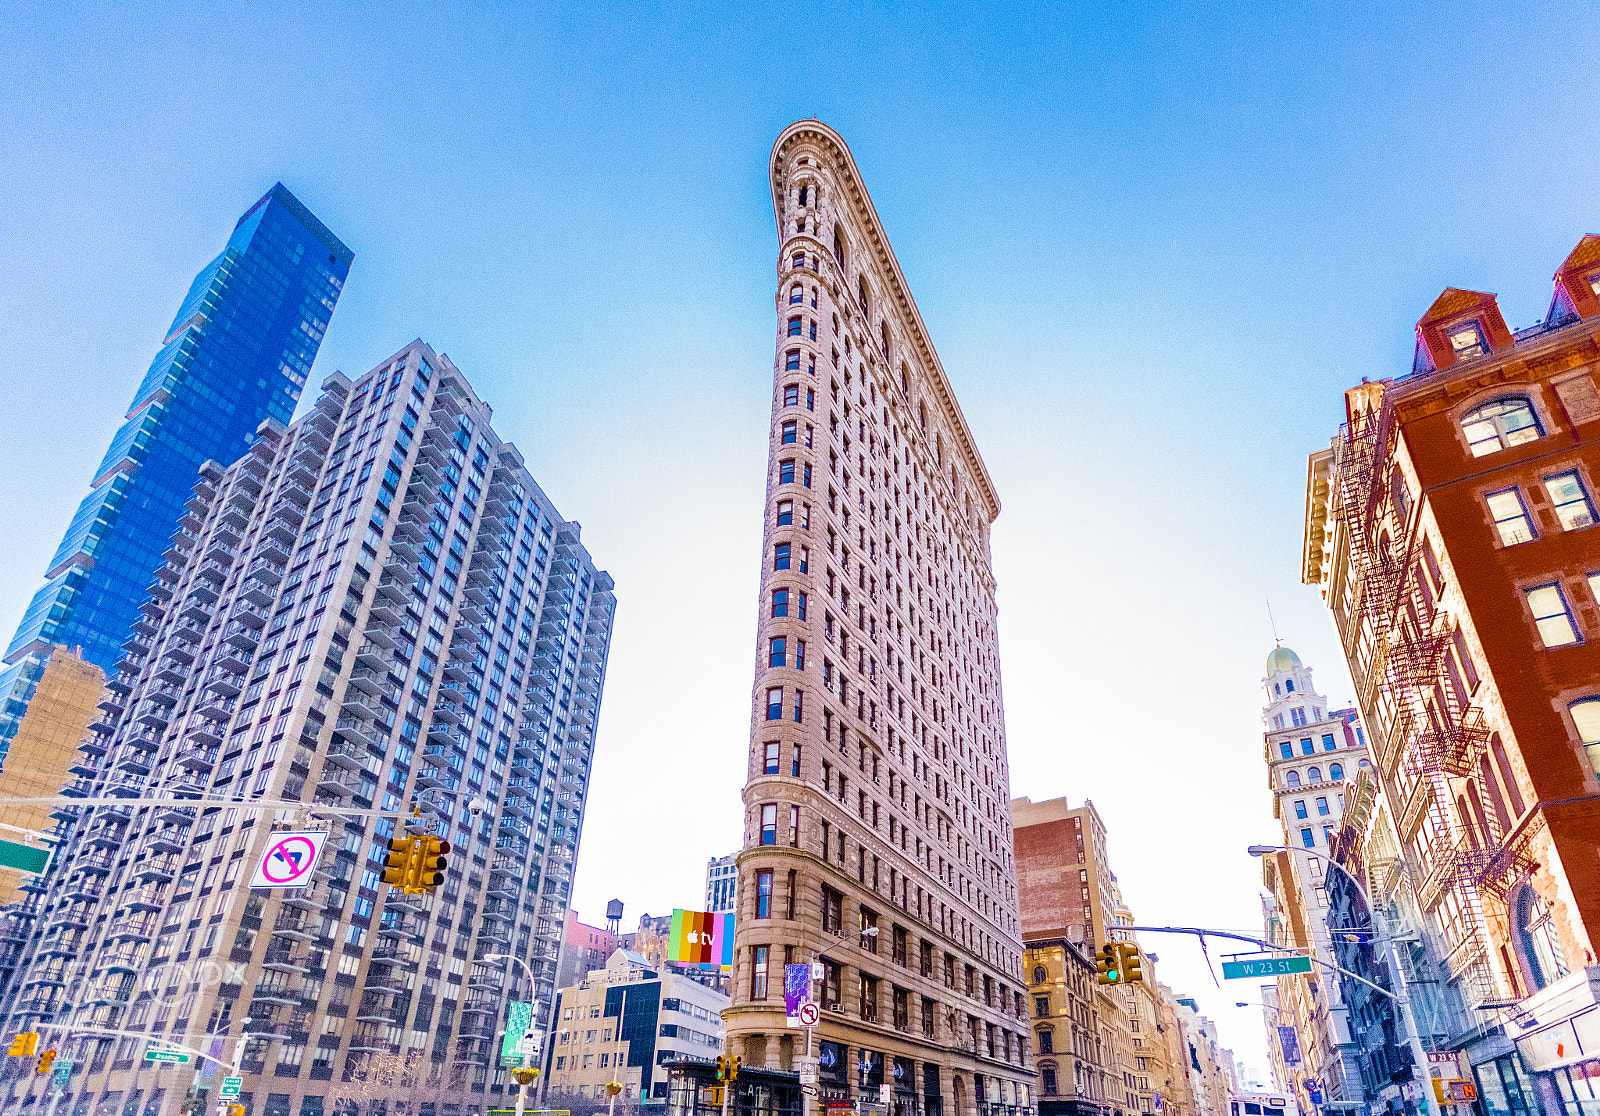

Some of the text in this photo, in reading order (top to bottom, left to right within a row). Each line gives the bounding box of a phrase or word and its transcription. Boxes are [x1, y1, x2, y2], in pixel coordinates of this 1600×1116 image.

[701, 931, 717, 946] tv
[1243, 961, 1291, 974] W 23 St
[1438, 1053, 1447, 1061] 23
[1448, 1053, 1457, 1061] St
